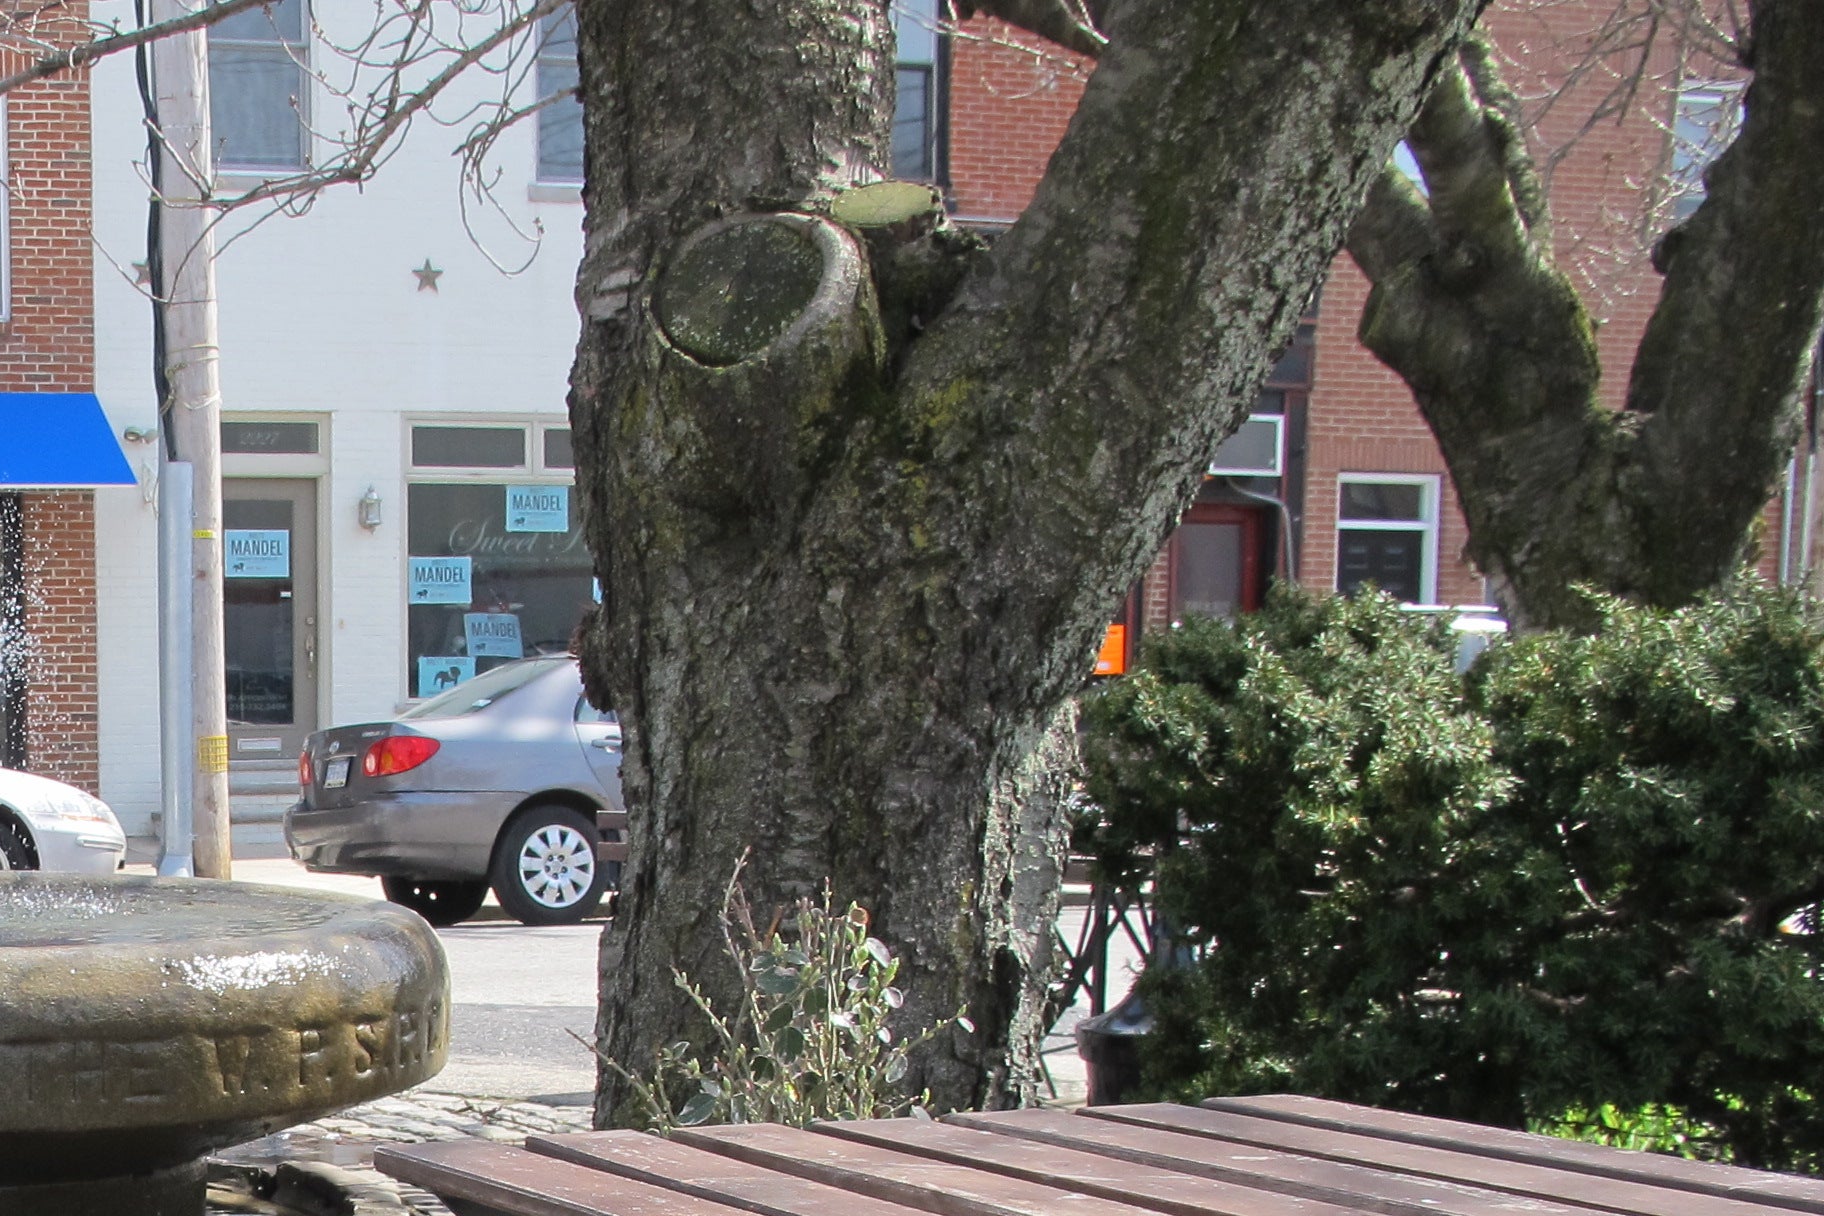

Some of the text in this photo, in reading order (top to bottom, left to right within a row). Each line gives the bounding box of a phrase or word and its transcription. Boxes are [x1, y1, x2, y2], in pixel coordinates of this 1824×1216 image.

[512, 494, 562, 511] MANDEL
[231, 540, 282, 556] MANDEL
[415, 566, 465, 583] MANDEL
[471, 622, 517, 638] MANDEL
